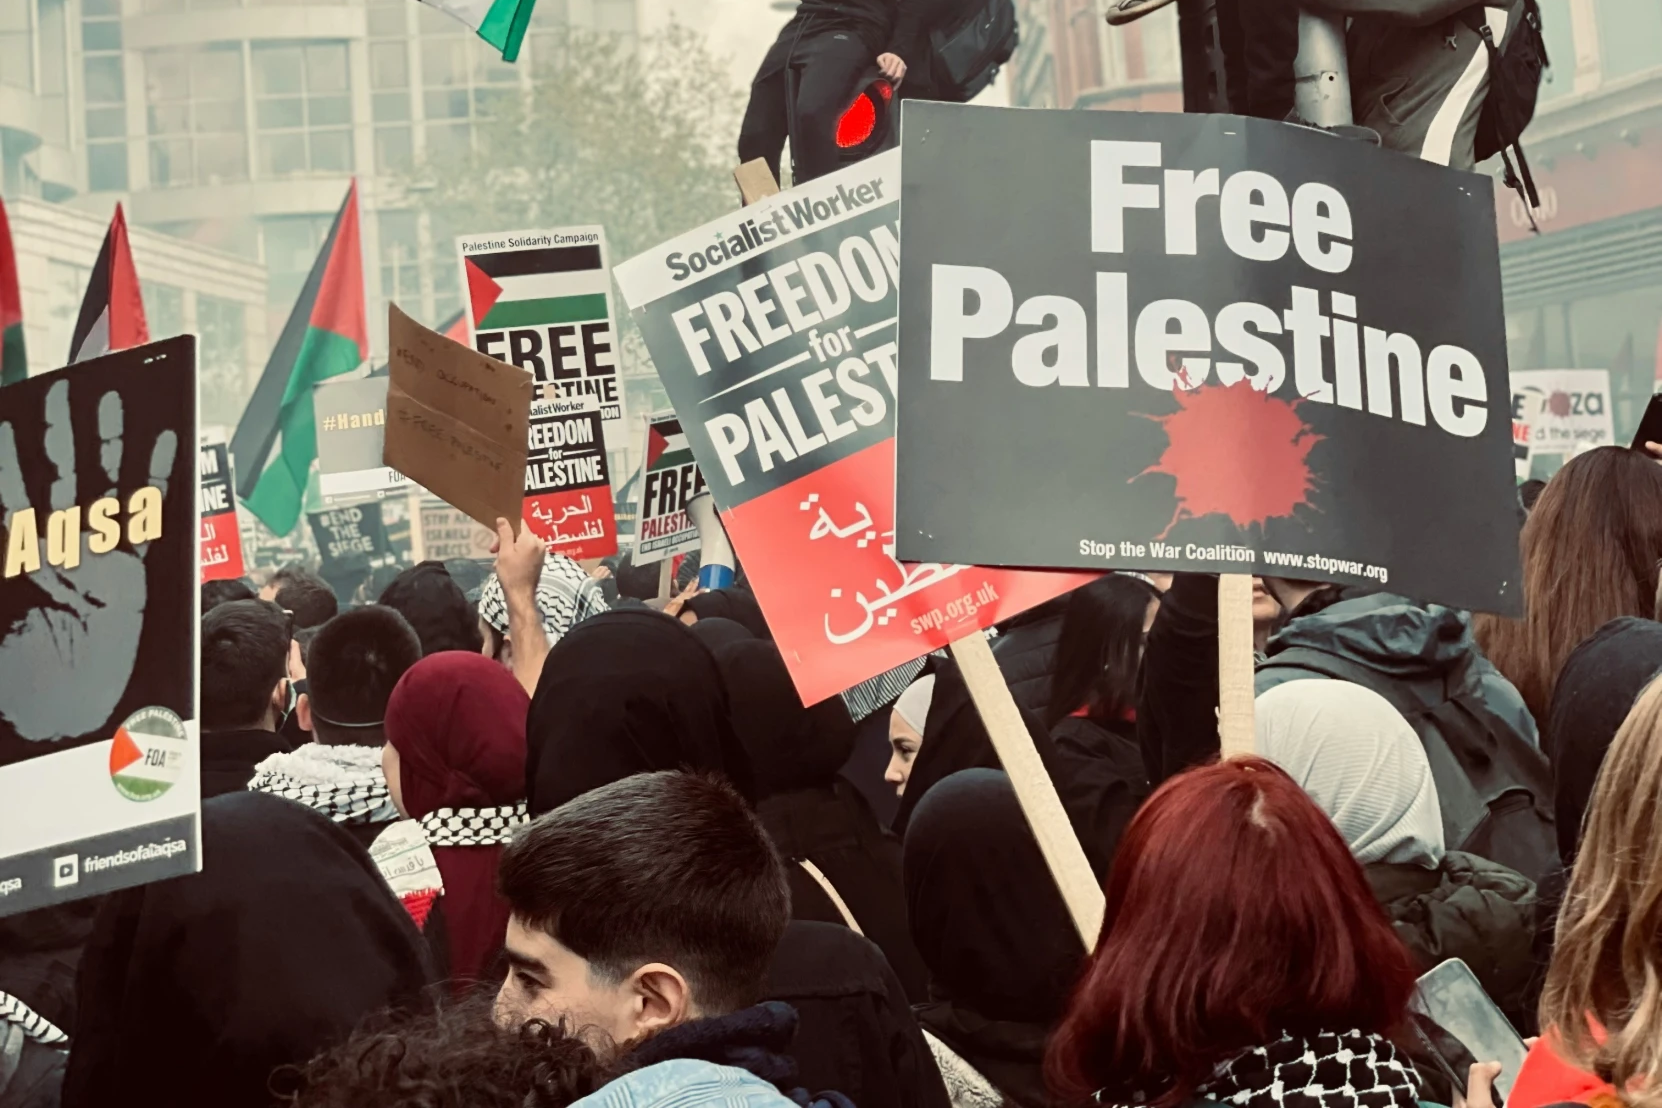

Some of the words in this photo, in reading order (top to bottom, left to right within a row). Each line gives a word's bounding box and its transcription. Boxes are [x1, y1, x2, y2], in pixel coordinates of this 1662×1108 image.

[1090, 139, 1353, 273] Free
[462, 240, 506, 252] Palestine
[508, 236, 551, 247] Solidarity
[554, 232, 599, 244] Campaign
[476, 322, 616, 381] FREE
[808, 325, 853, 363] for
[930, 263, 1488, 437] Palestine
[548, 448, 563, 461] for
[531, 494, 592, 525] الحرية
[4, 486, 163, 578] Aqsa
[328, 536, 374, 557] SIEGE
[329, 524, 361, 541] THE
[534, 519, 604, 549] لفلسطي
[1079, 539, 1115, 559] Stop
[1120, 541, 1145, 558] the
[1149, 542, 1181, 559] War
[1185, 543, 1255, 563] Coalition
[1263, 550, 1388, 582] www.stopwar.org
[910, 580, 999, 635] swp.org.uk
[144, 748, 167, 767] FOA
